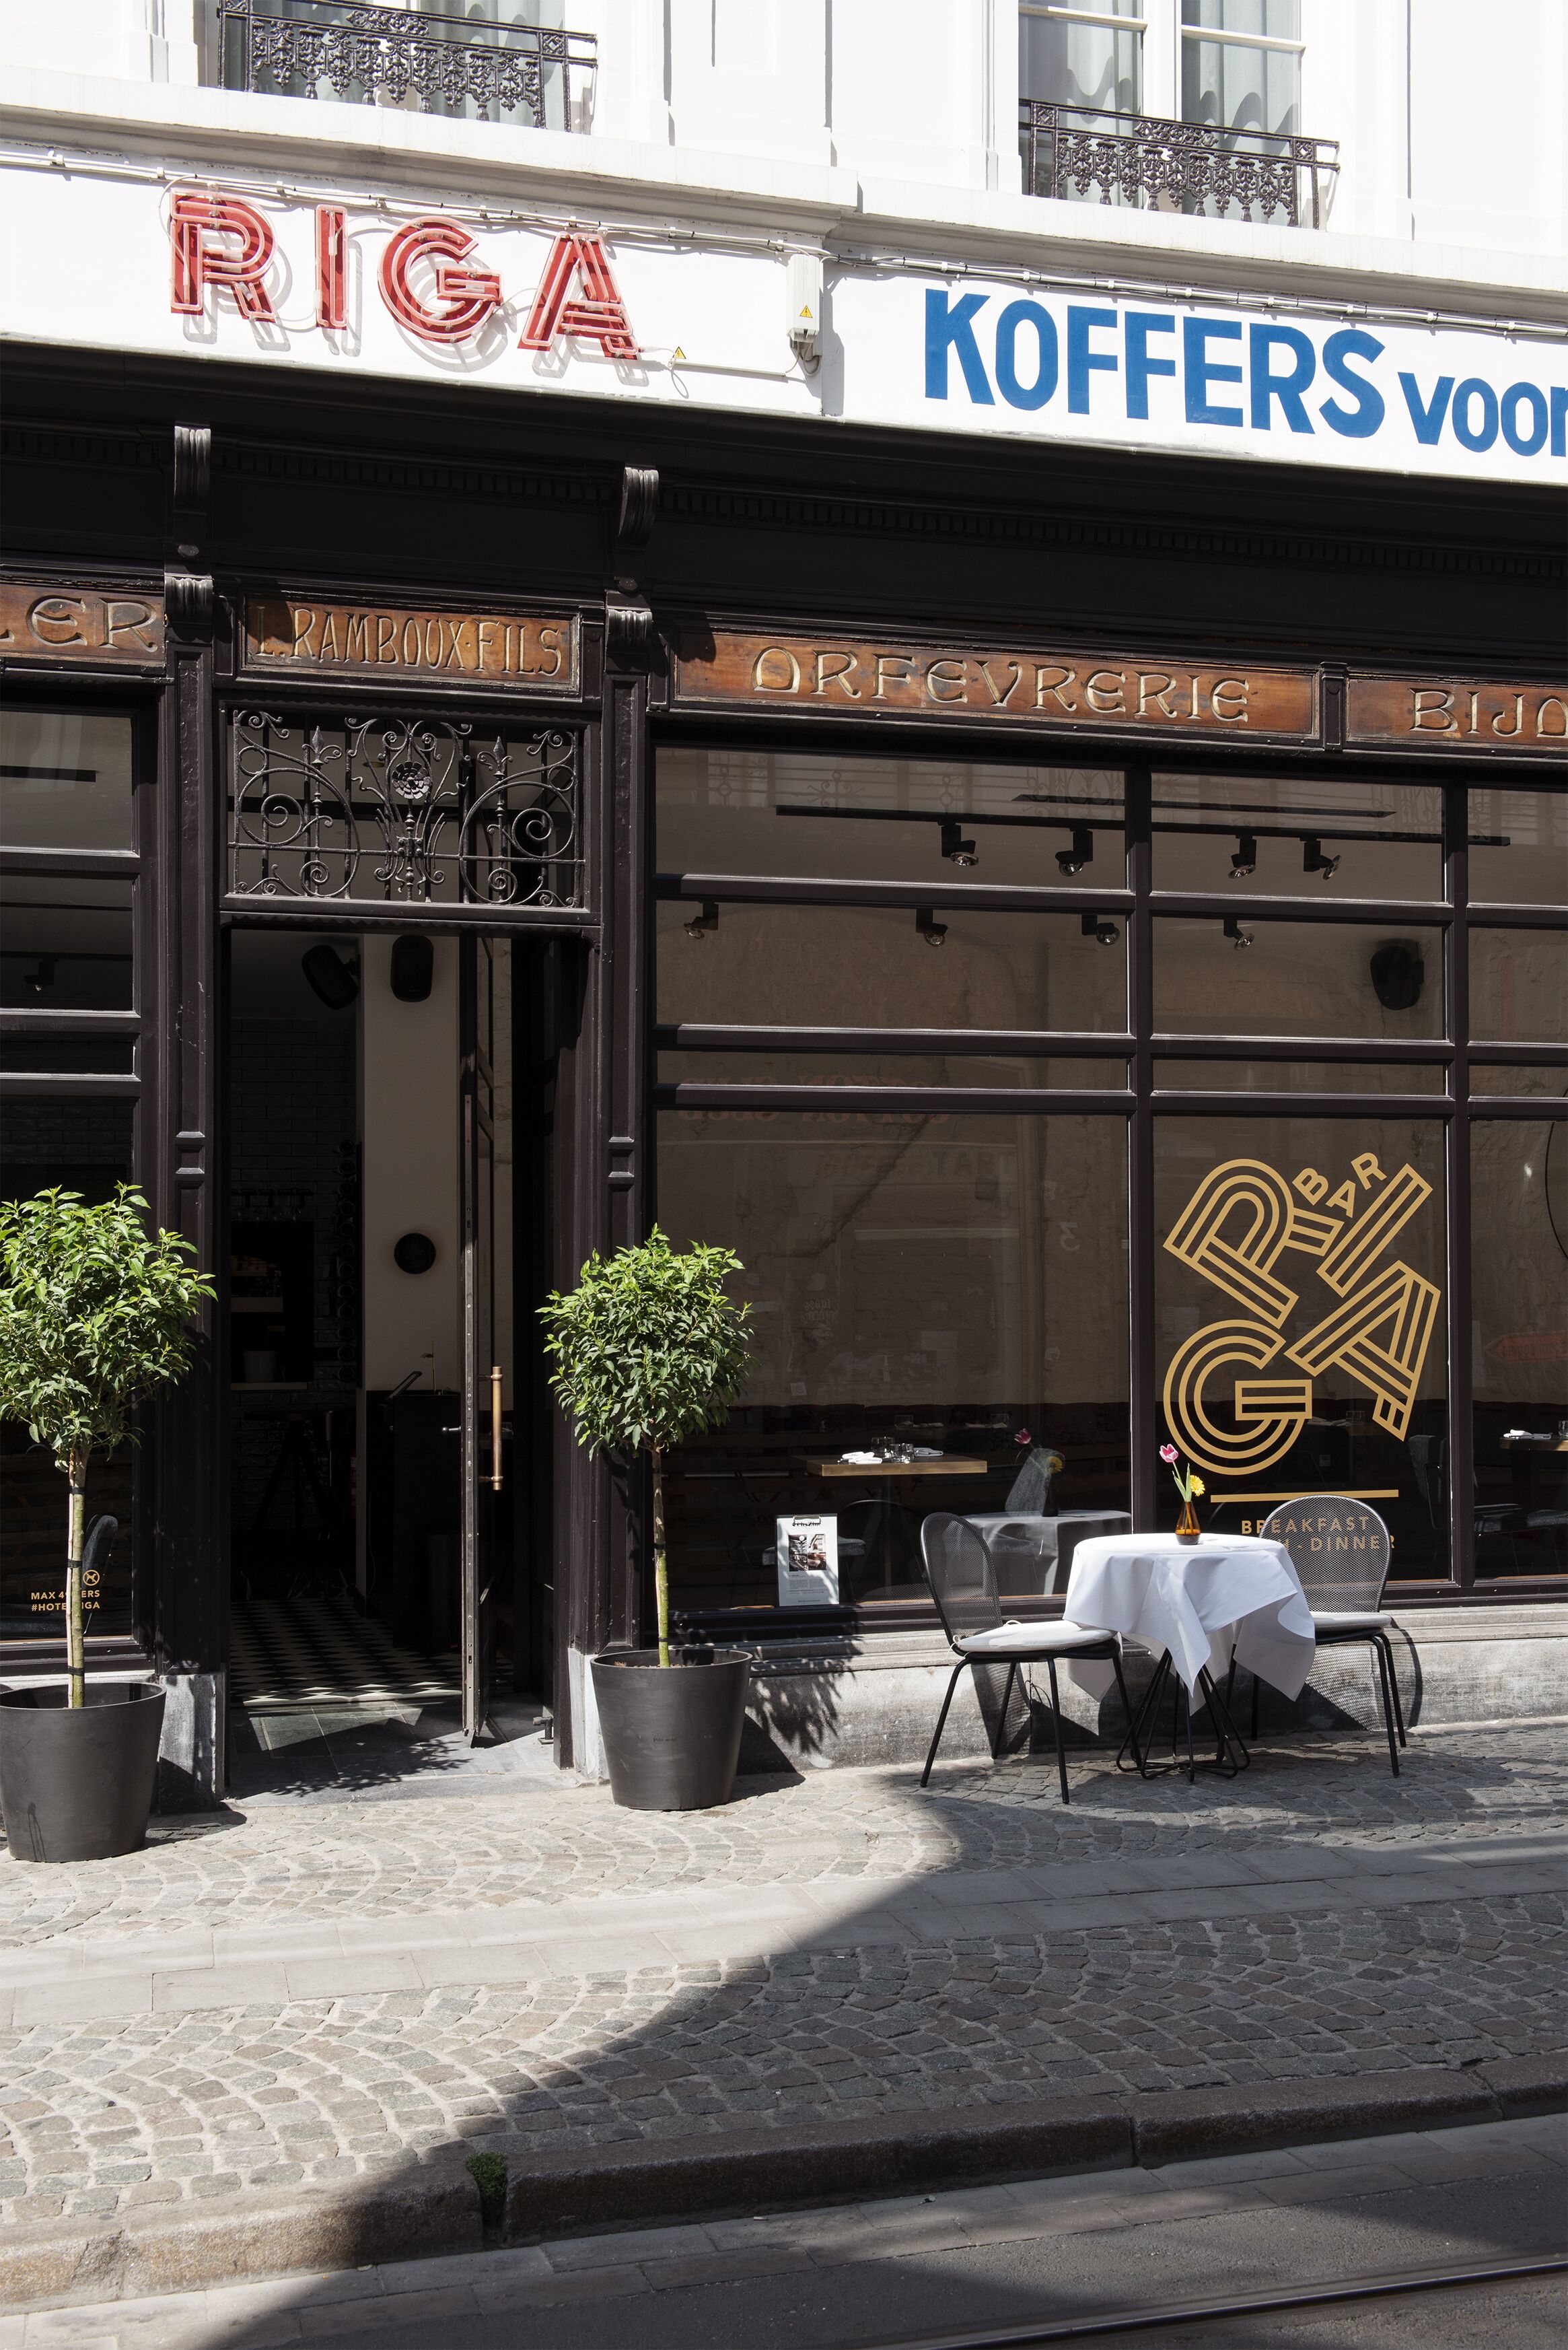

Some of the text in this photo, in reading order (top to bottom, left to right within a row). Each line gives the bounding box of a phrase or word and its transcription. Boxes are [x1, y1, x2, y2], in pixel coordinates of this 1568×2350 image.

[170, 190, 639, 359] RIGA
[925, 288, 1386, 439] KOFFERS
[0, 594, 158, 652] ER
[751, 645, 1250, 723] ORFEVRERIE
[1291, 1152, 1386, 1217] BAR
[31, 1591, 56, 1600] MAX
[32, 1601, 100, 1612] #HOTEIGA
